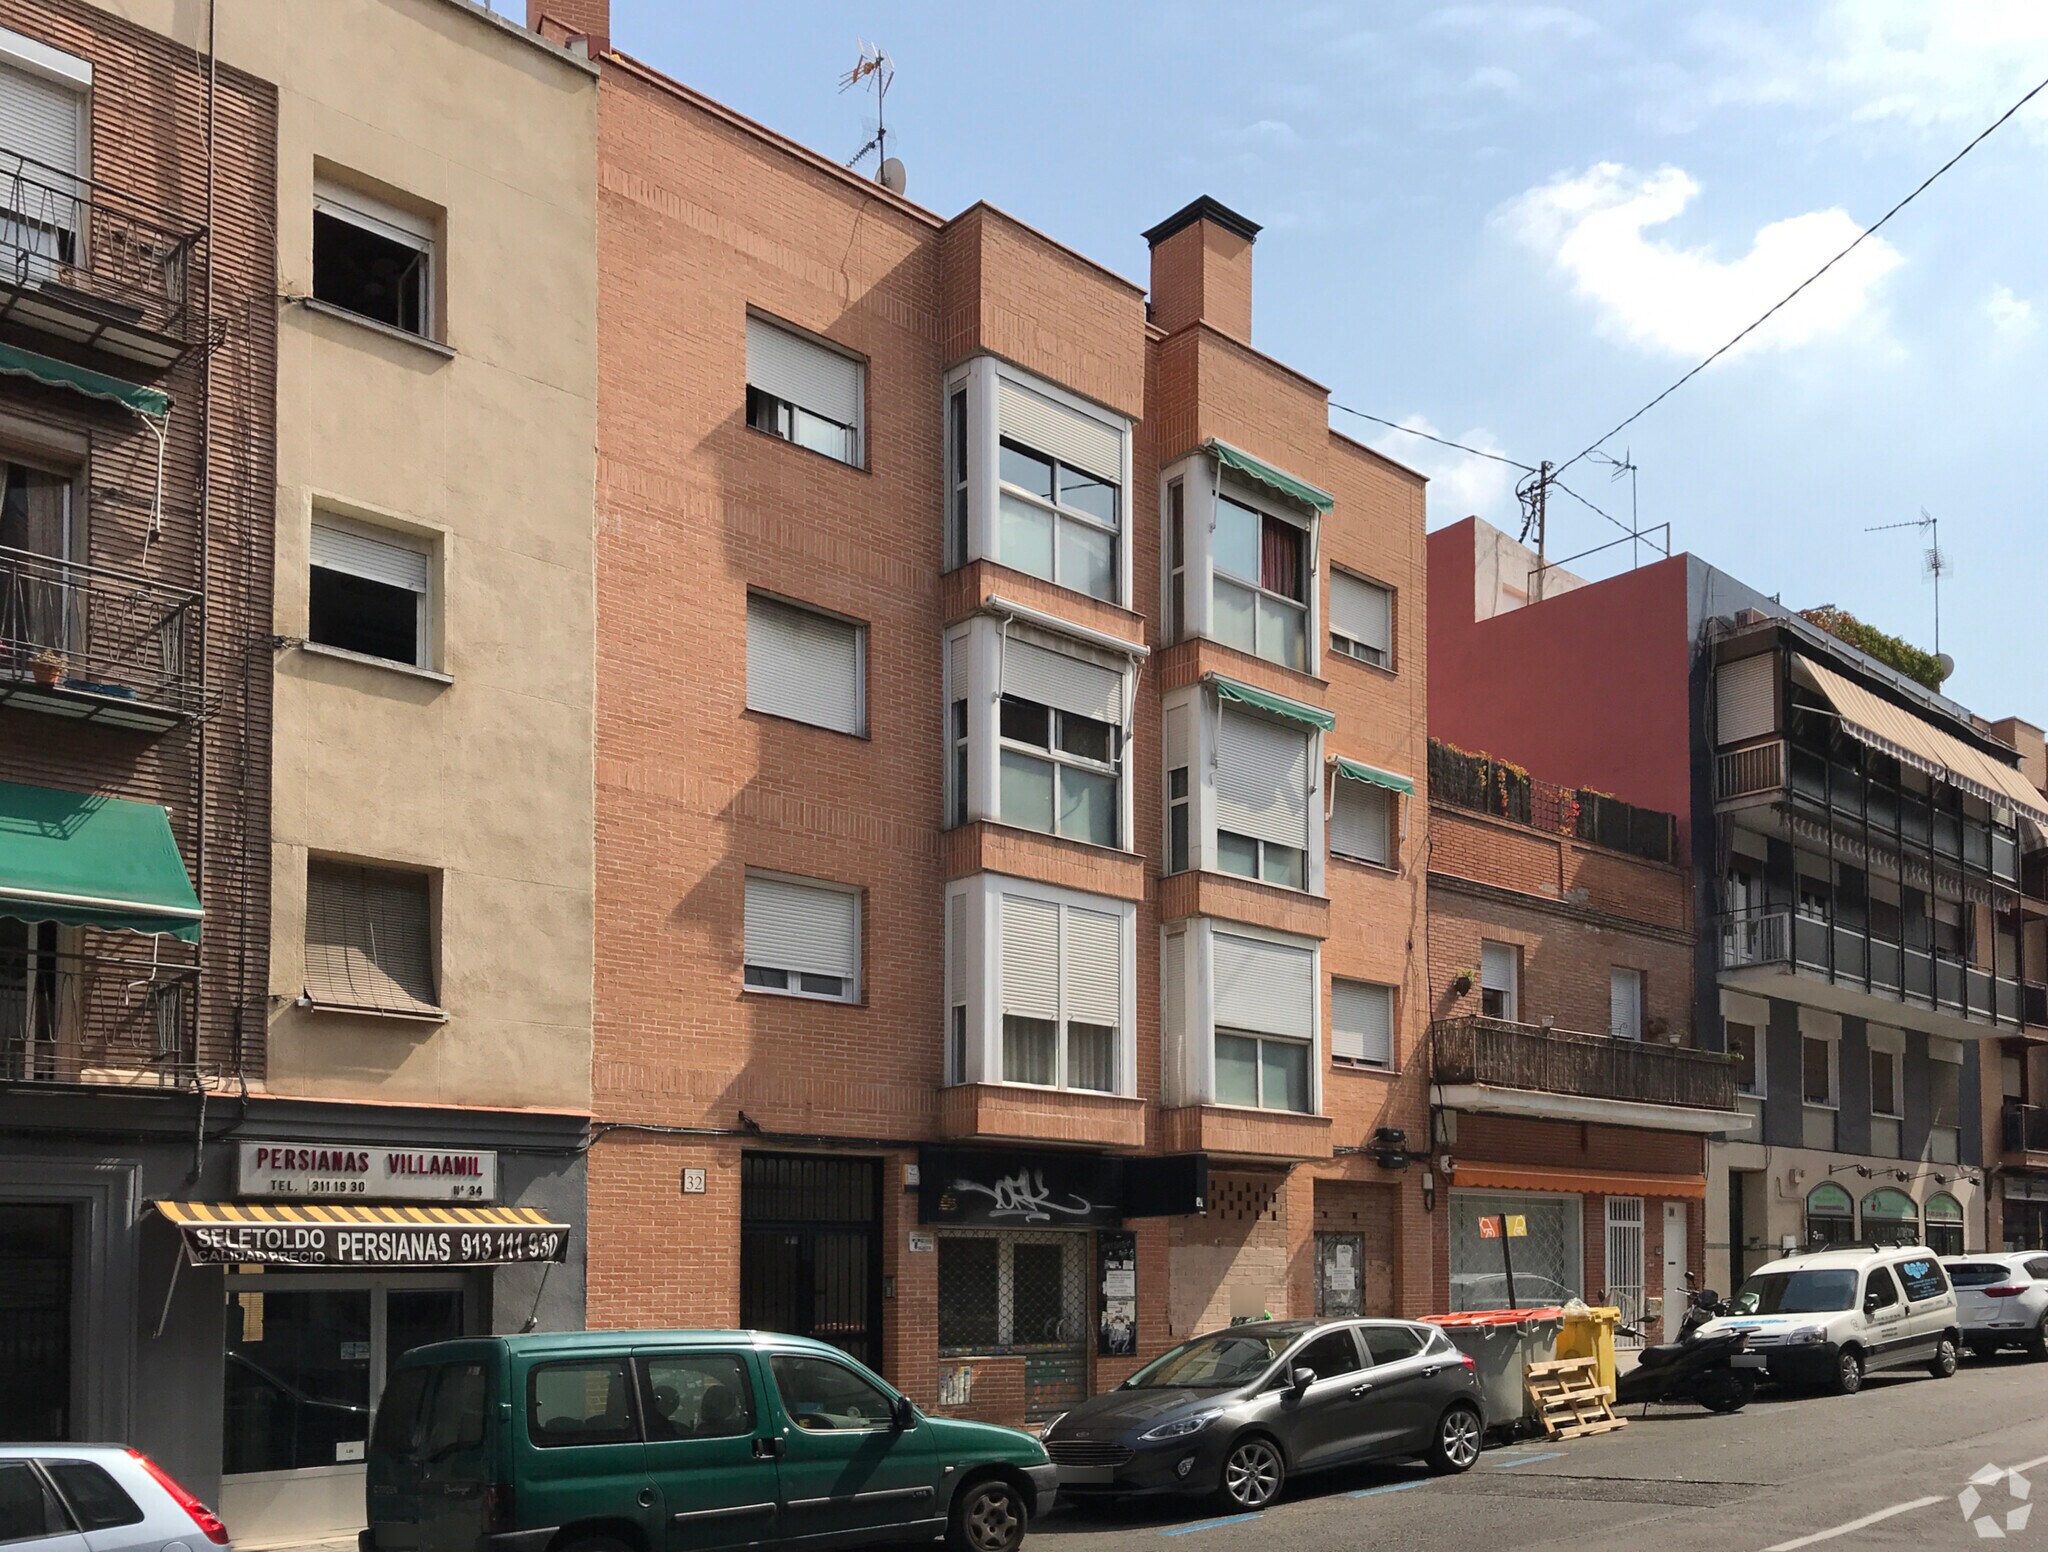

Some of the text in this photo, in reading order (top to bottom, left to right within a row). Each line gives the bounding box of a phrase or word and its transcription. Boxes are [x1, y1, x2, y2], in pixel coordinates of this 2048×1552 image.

[257, 1147, 484, 1177] PERSIANAS VILLAAMIL
[311, 1181, 330, 1192] 311
[334, 1181, 347, 1192] 19
[350, 1181, 366, 1193] 30
[468, 1185, 484, 1196] 34
[686, 1175, 703, 1191] 32
[196, 1228, 326, 1249] SELETOLDO
[337, 1231, 559, 1261] PERSIANAS 913 111 930
[197, 1250, 326, 1263] CALIDAD PRECIO
